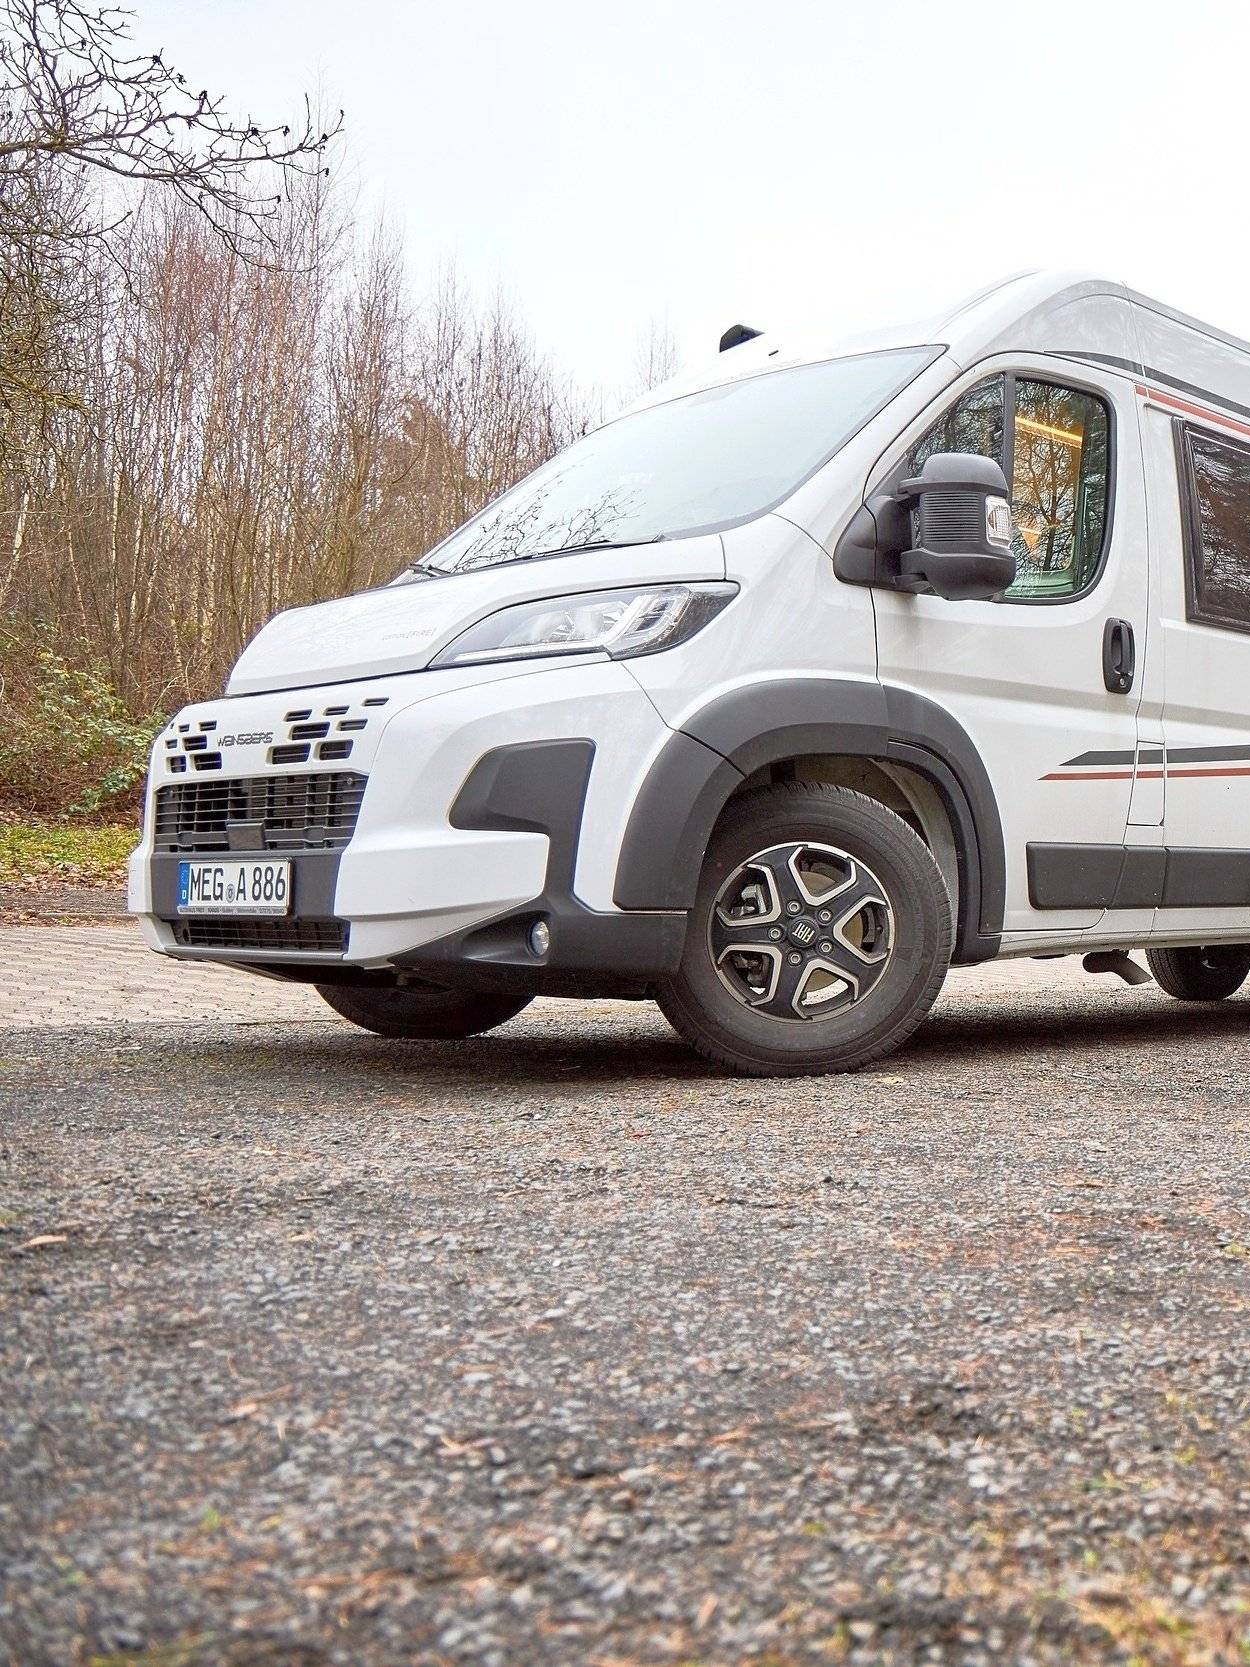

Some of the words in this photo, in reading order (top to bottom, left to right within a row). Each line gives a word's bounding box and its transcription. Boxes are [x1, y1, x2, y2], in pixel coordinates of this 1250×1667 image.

[217, 731, 274, 747] WEINSBERG
[190, 867, 224, 901] MEG
[235, 867, 247, 901] A
[251, 866, 286, 901] 886
[792, 923, 815, 943] FIAT
